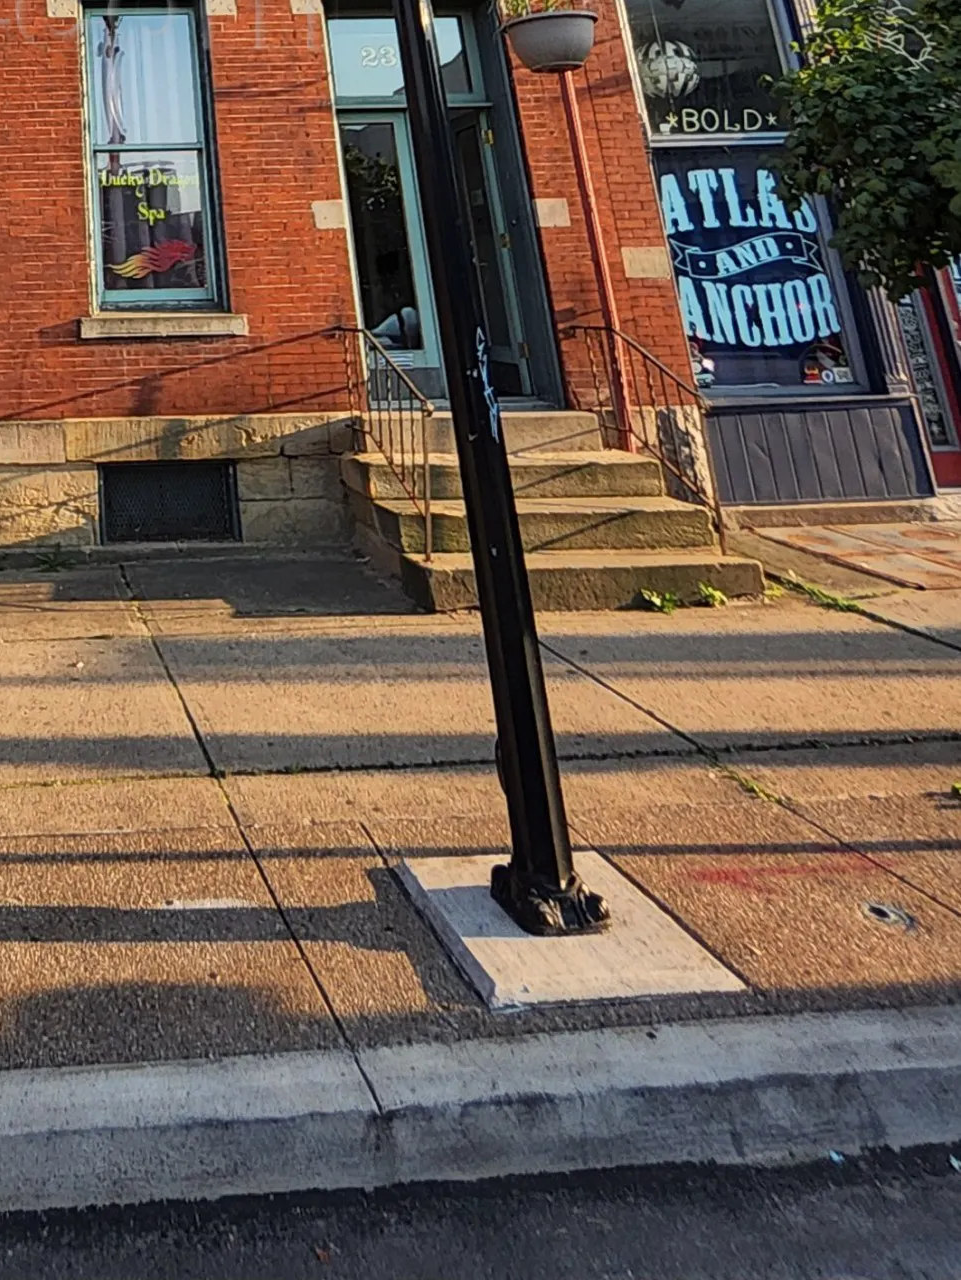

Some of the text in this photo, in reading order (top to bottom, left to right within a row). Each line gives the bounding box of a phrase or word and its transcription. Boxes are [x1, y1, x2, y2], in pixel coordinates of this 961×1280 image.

[138, 201, 165, 226] Spa
[716, 237, 780, 276] AND
[678, 272, 841, 347] ANCHOR
